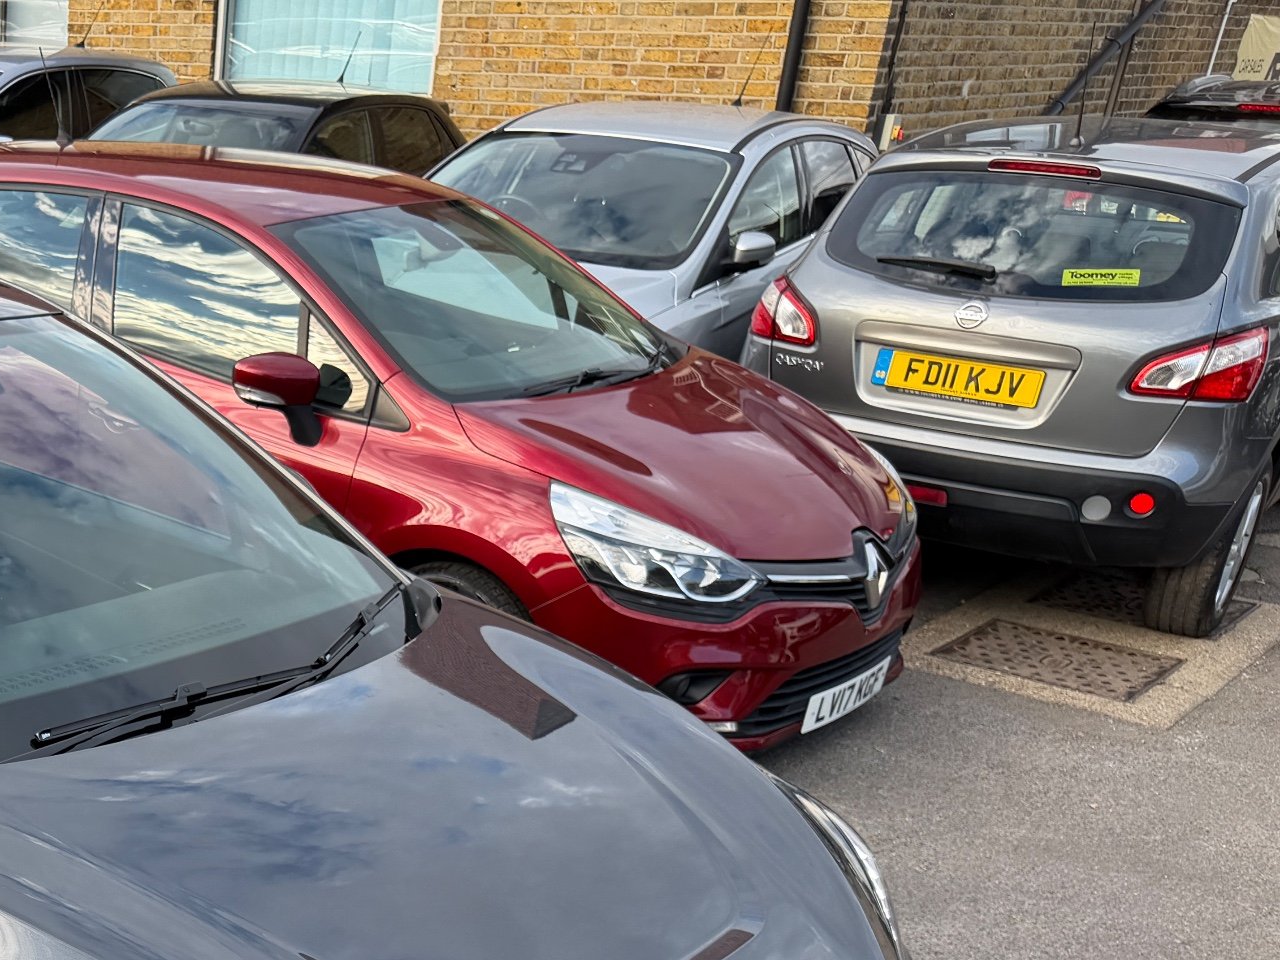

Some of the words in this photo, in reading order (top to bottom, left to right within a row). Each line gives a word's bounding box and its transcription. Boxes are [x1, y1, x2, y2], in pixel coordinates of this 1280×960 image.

[1068, 270, 1118, 281] Toomey
[903, 357, 960, 390] FD11
[964, 365, 1026, 399] KJV
